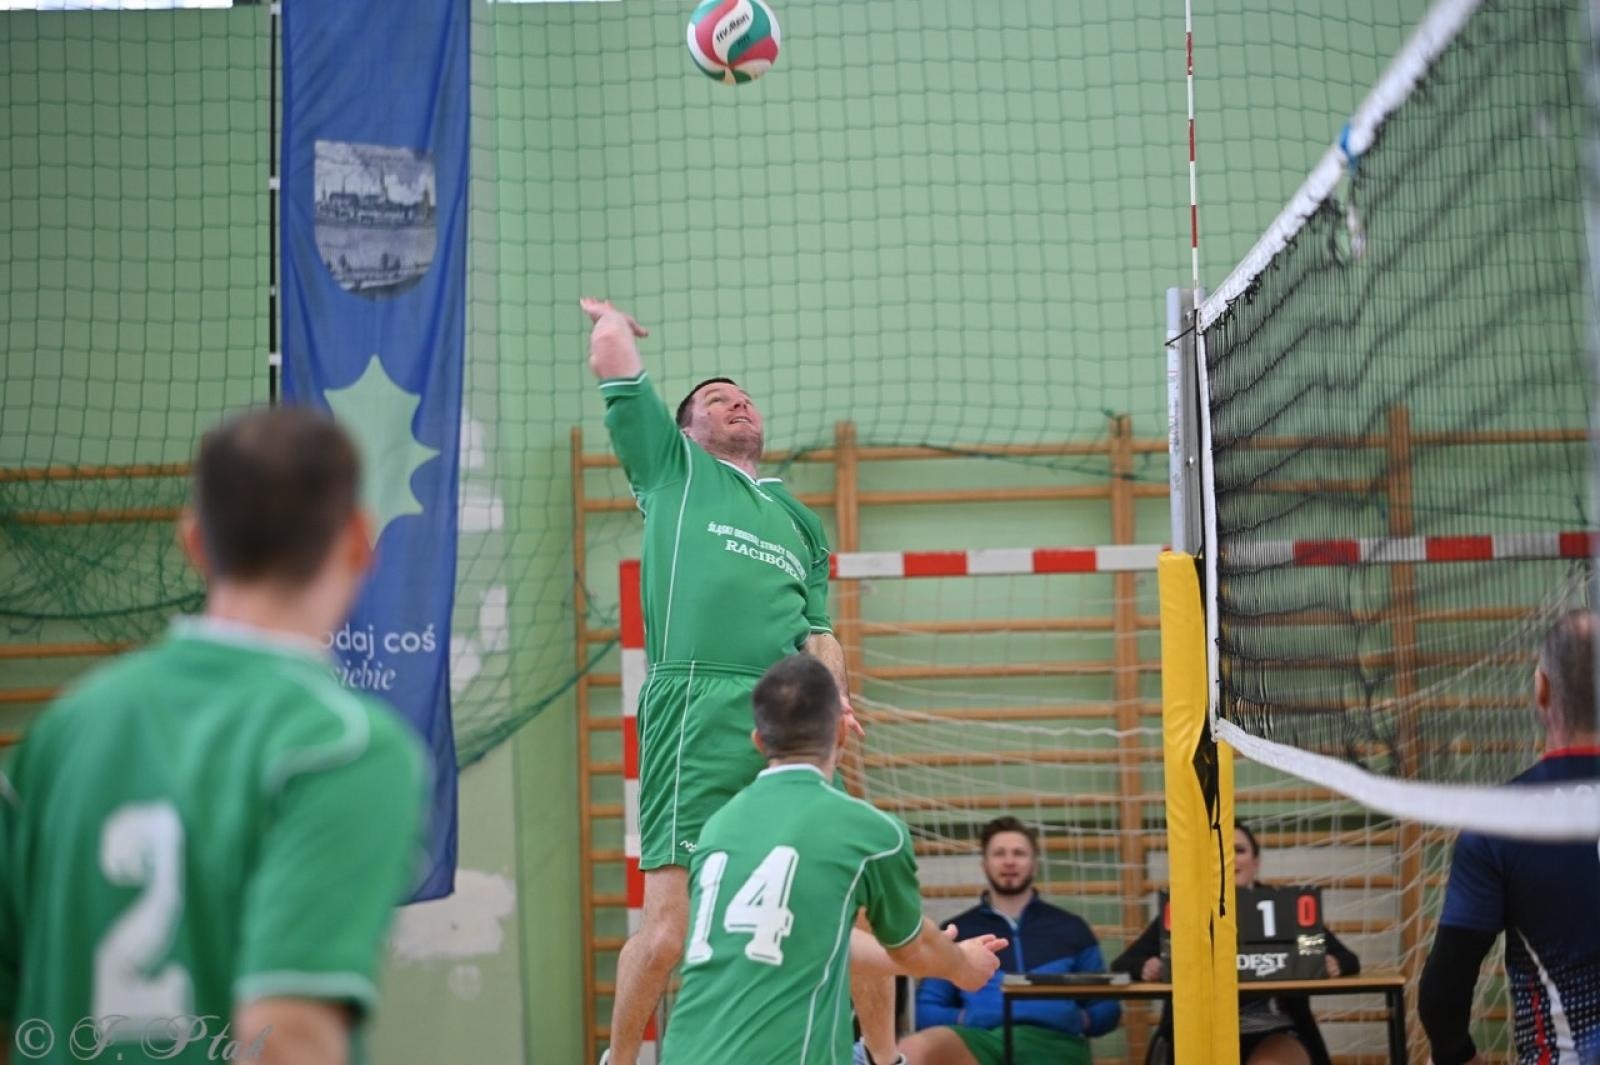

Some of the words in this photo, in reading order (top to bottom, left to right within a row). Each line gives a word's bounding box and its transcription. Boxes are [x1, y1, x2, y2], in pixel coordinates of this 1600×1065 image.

[321, 622, 375, 660] odaj
[383, 623, 437, 653] coś
[92, 800, 195, 1043] 2
[687, 845, 799, 966] 14
[1256, 900, 1277, 938] 1
[1296, 894, 1318, 928] 0
